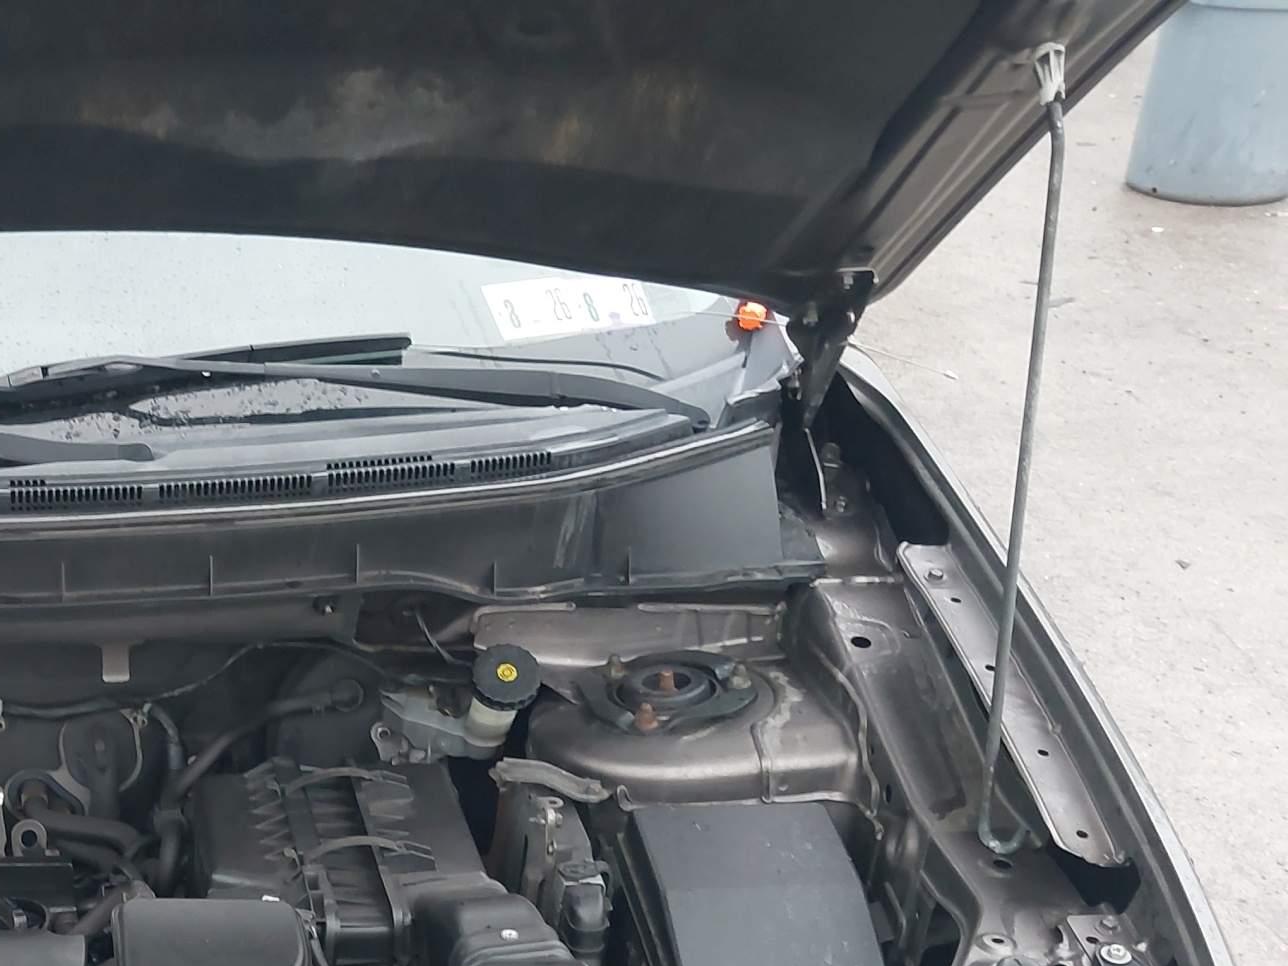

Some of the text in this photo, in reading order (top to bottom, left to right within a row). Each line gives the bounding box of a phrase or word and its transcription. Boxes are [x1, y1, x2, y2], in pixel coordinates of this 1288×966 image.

[544, 287, 573, 321] 26
[583, 282, 649, 322] 8 26
